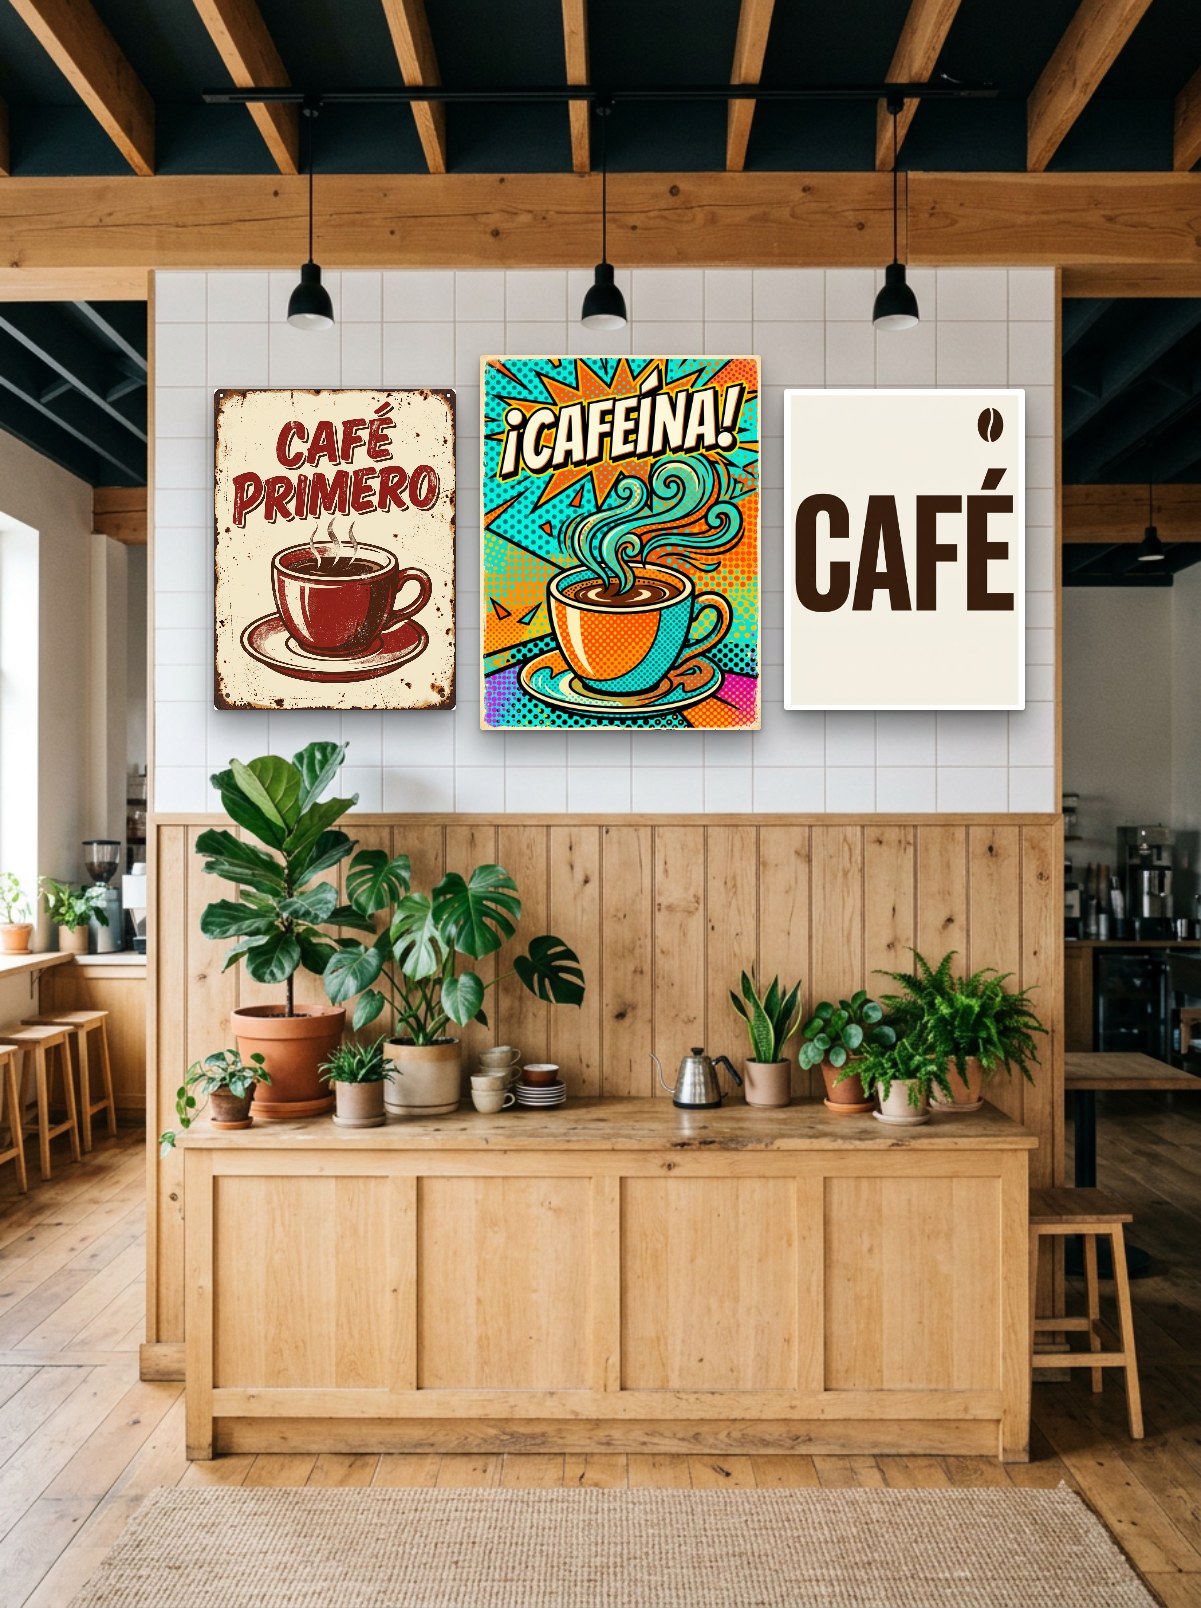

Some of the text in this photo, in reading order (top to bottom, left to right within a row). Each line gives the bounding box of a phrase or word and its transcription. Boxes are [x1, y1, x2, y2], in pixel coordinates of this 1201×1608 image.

[275, 402, 395, 470] CAFÉ
[500, 367, 745, 479] ¡CAFEÍNA!
[233, 464, 440, 528] PRIMERO
[795, 468, 1014, 612] CAFÉ
